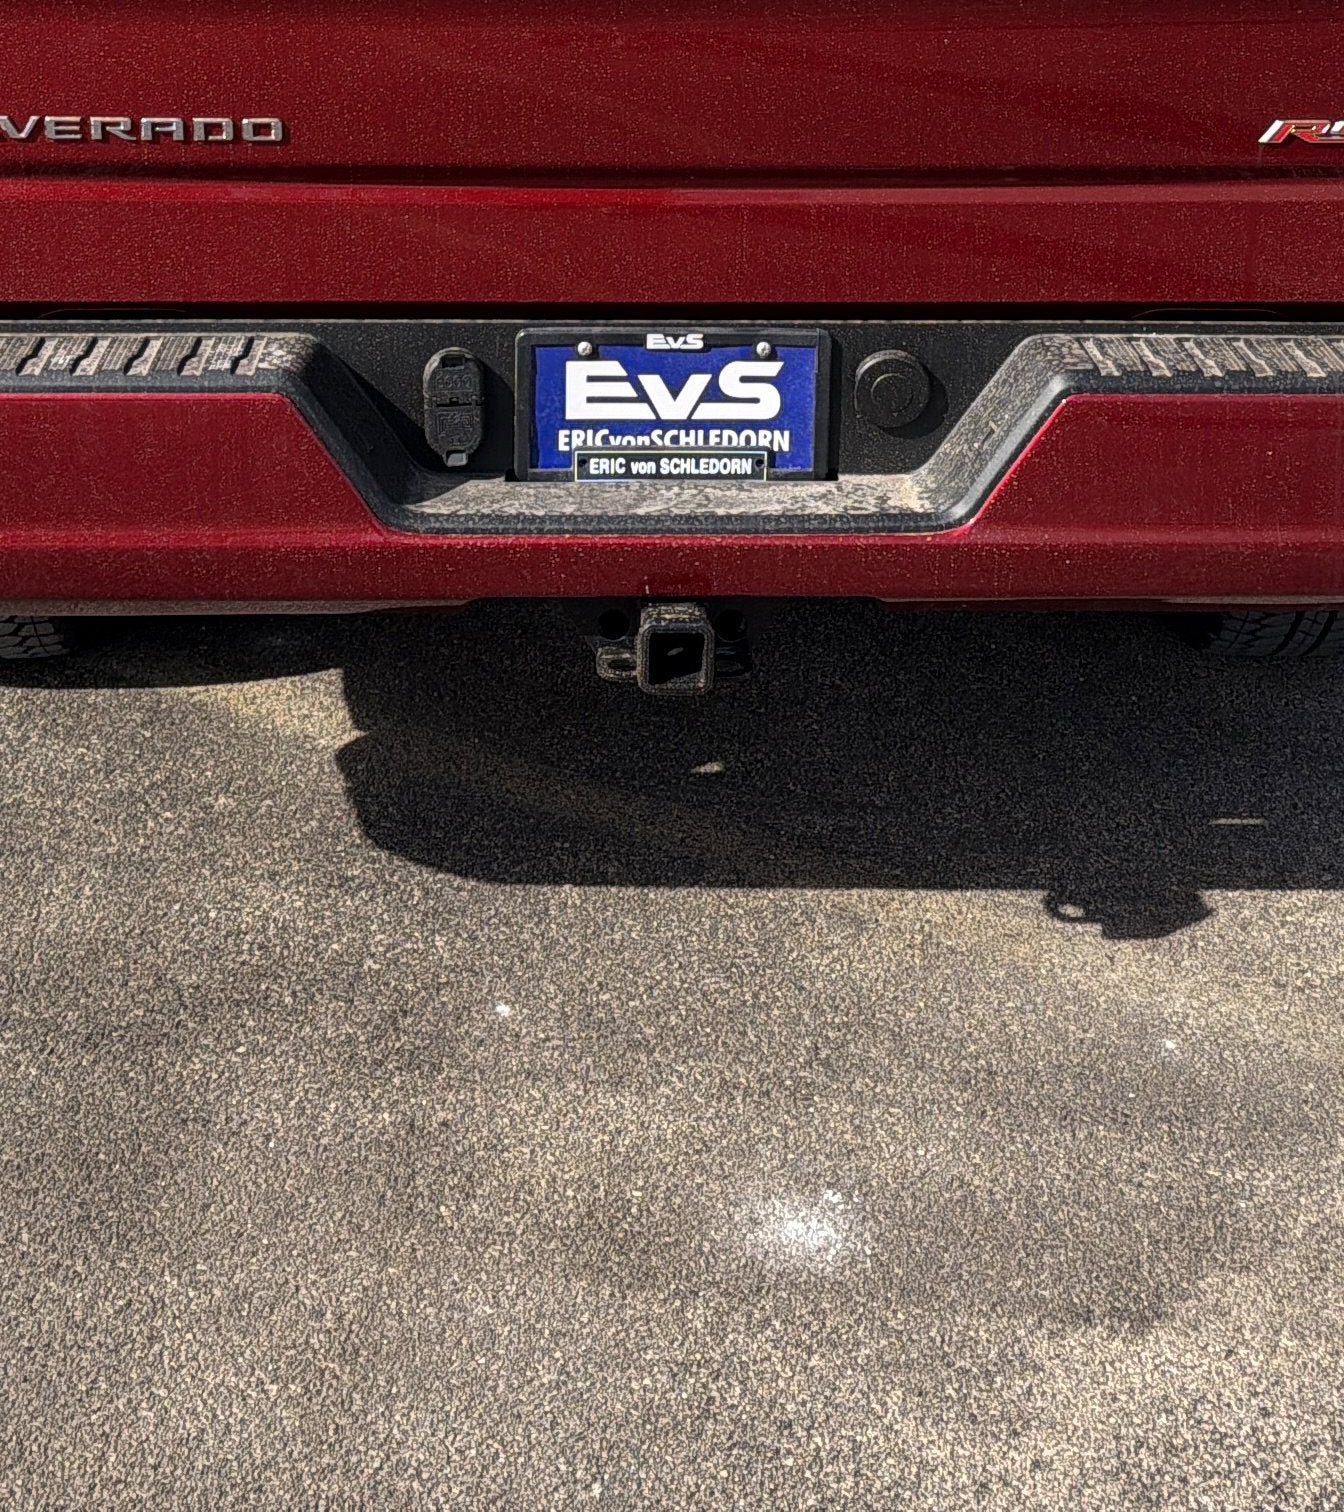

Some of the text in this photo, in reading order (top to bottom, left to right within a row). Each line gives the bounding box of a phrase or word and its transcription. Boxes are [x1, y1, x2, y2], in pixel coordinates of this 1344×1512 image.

[589, 457, 753, 475] ERIC von SCHLEDORN
